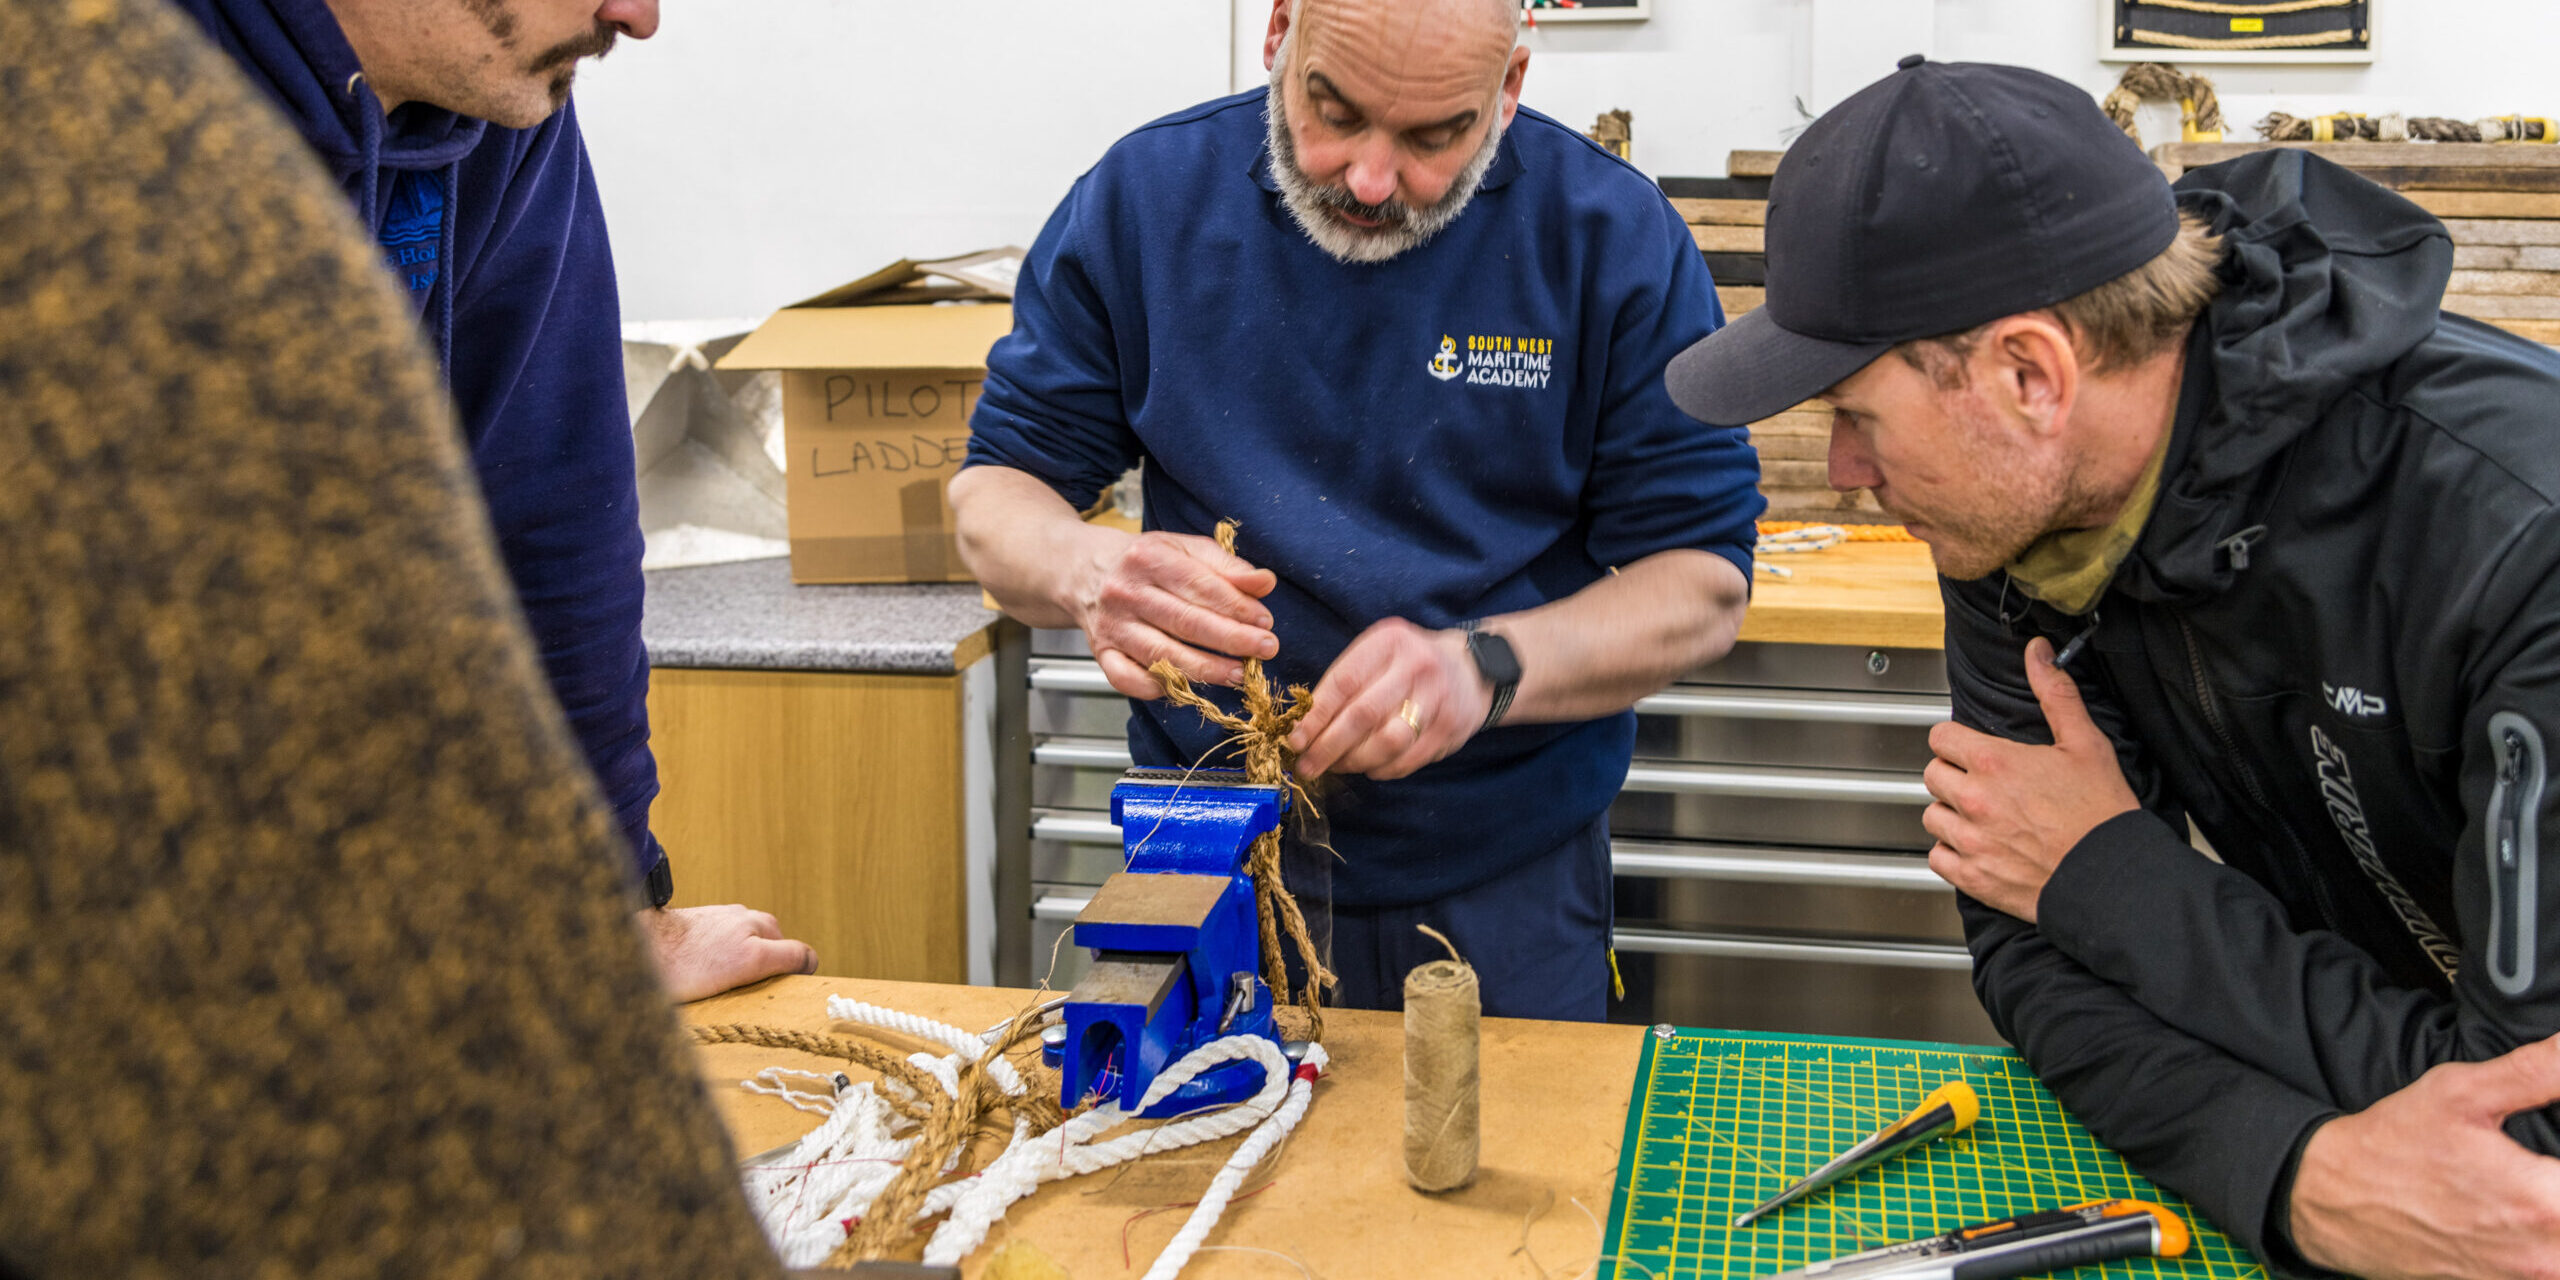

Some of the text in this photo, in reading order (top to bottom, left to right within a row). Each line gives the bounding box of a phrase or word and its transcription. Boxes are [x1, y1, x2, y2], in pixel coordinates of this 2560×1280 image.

[1468, 335, 1552, 354] SOUTH WEST
[1468, 351, 1551, 371] MARITIME
[1466, 367, 1550, 388] ACADEMY
[824, 374, 984, 422] PILOT
